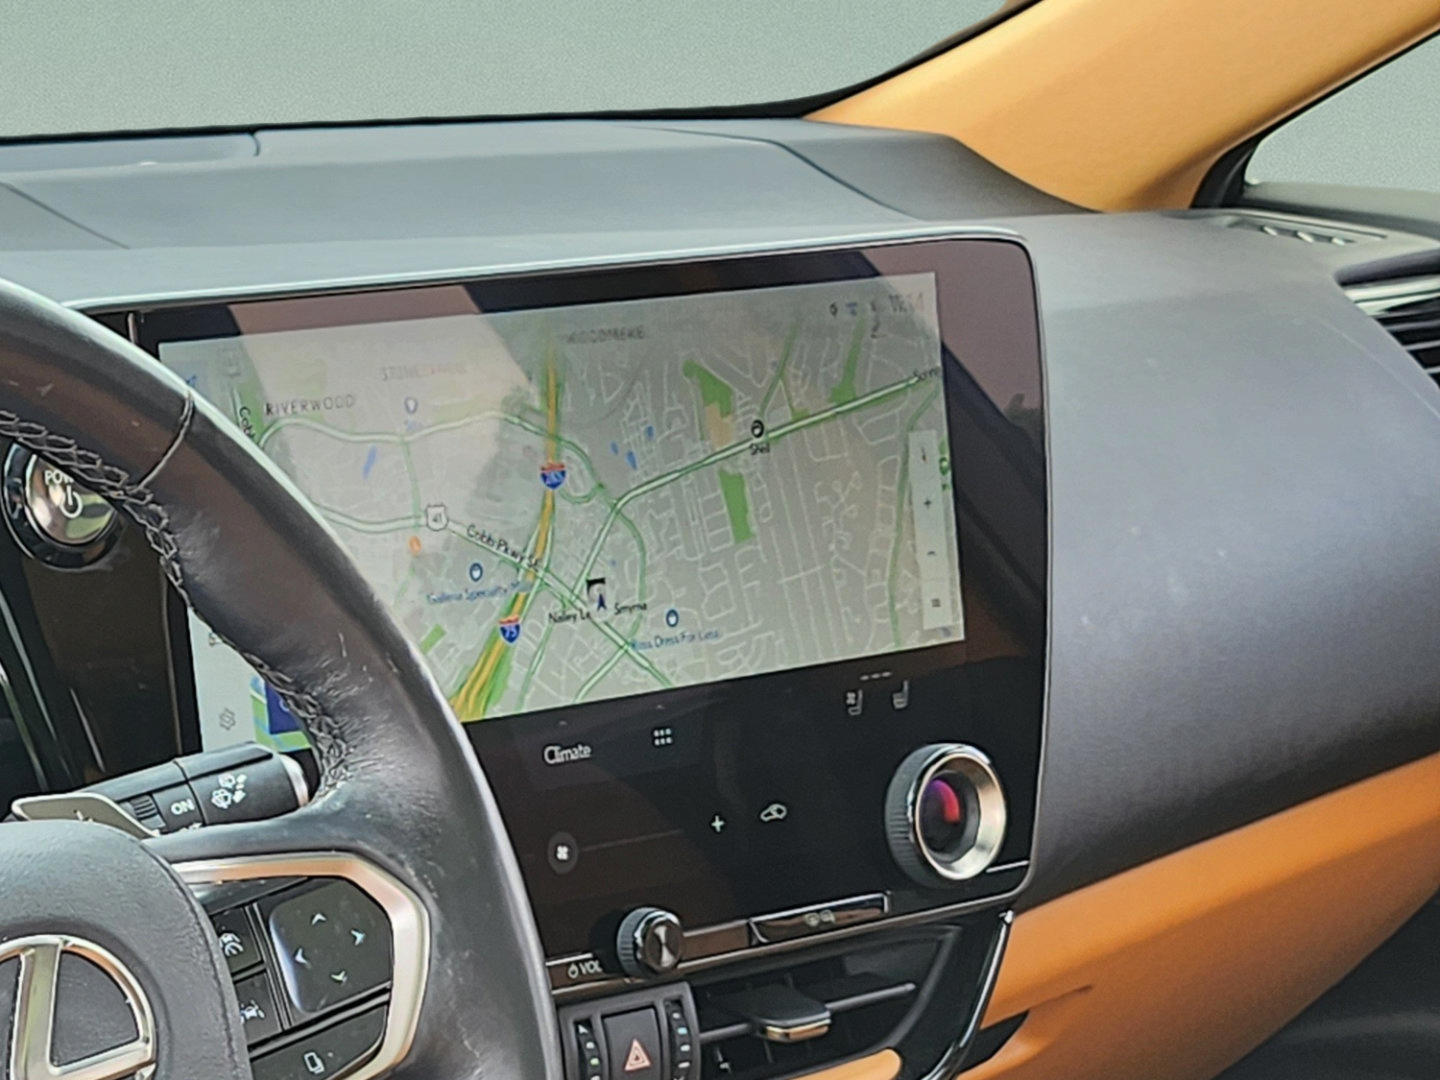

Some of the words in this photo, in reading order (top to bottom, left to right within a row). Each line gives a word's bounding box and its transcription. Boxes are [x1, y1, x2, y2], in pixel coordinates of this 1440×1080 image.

[265, 394, 355, 417] RIVERWOOD
[543, 743, 592, 765] Climate
[170, 798, 195, 815] ON
[578, 959, 603, 975] VOL
